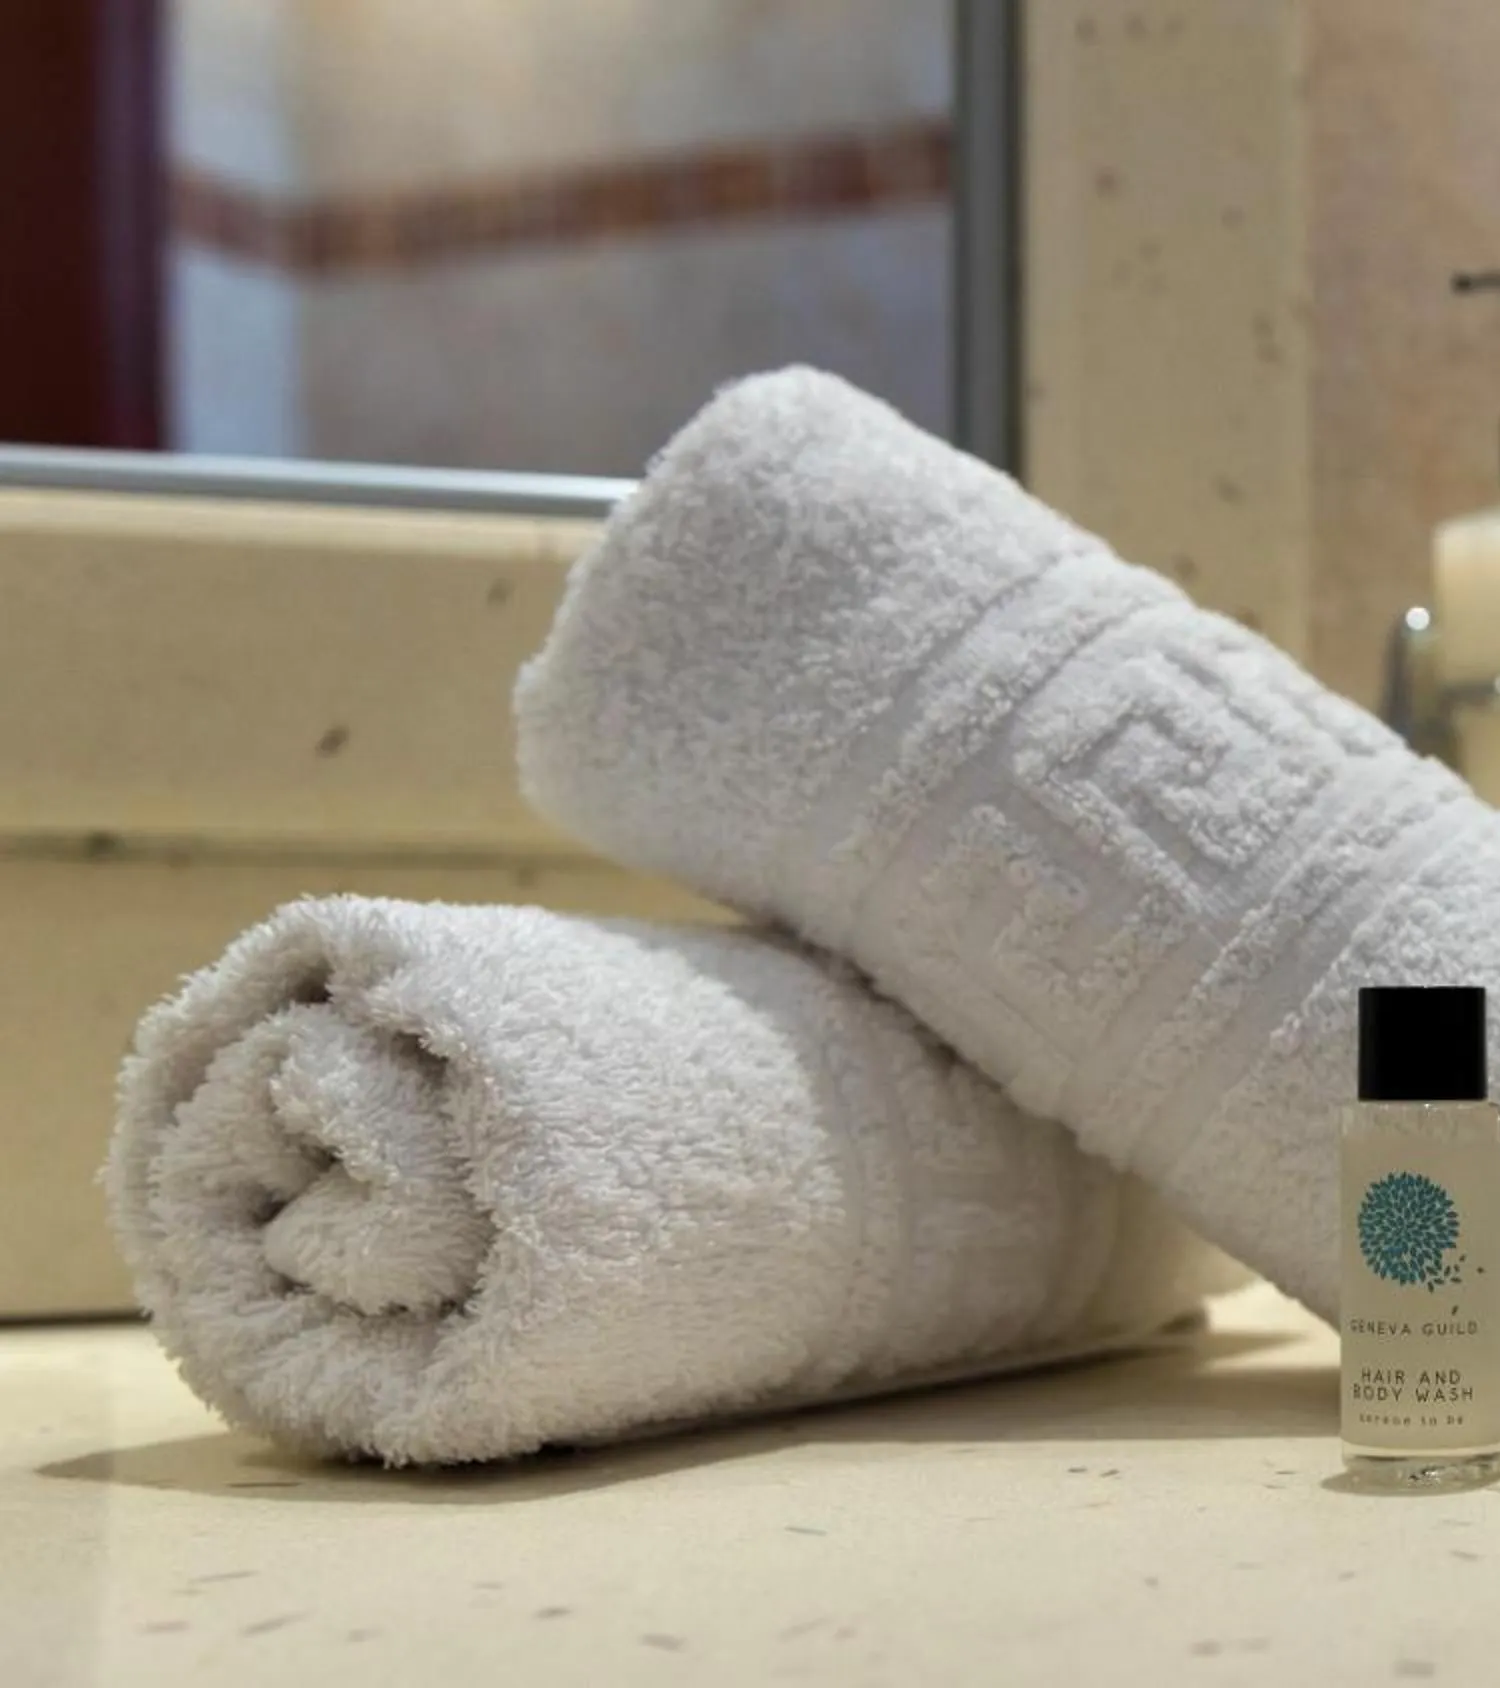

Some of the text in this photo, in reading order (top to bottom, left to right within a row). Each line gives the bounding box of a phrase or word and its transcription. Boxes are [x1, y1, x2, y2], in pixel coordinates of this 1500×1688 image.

[1349, 1319, 1478, 1336] GENEVA GUILD
[1361, 1367, 1461, 1385] HAIR AND
[1352, 1383, 1474, 1403] BODY WASH
